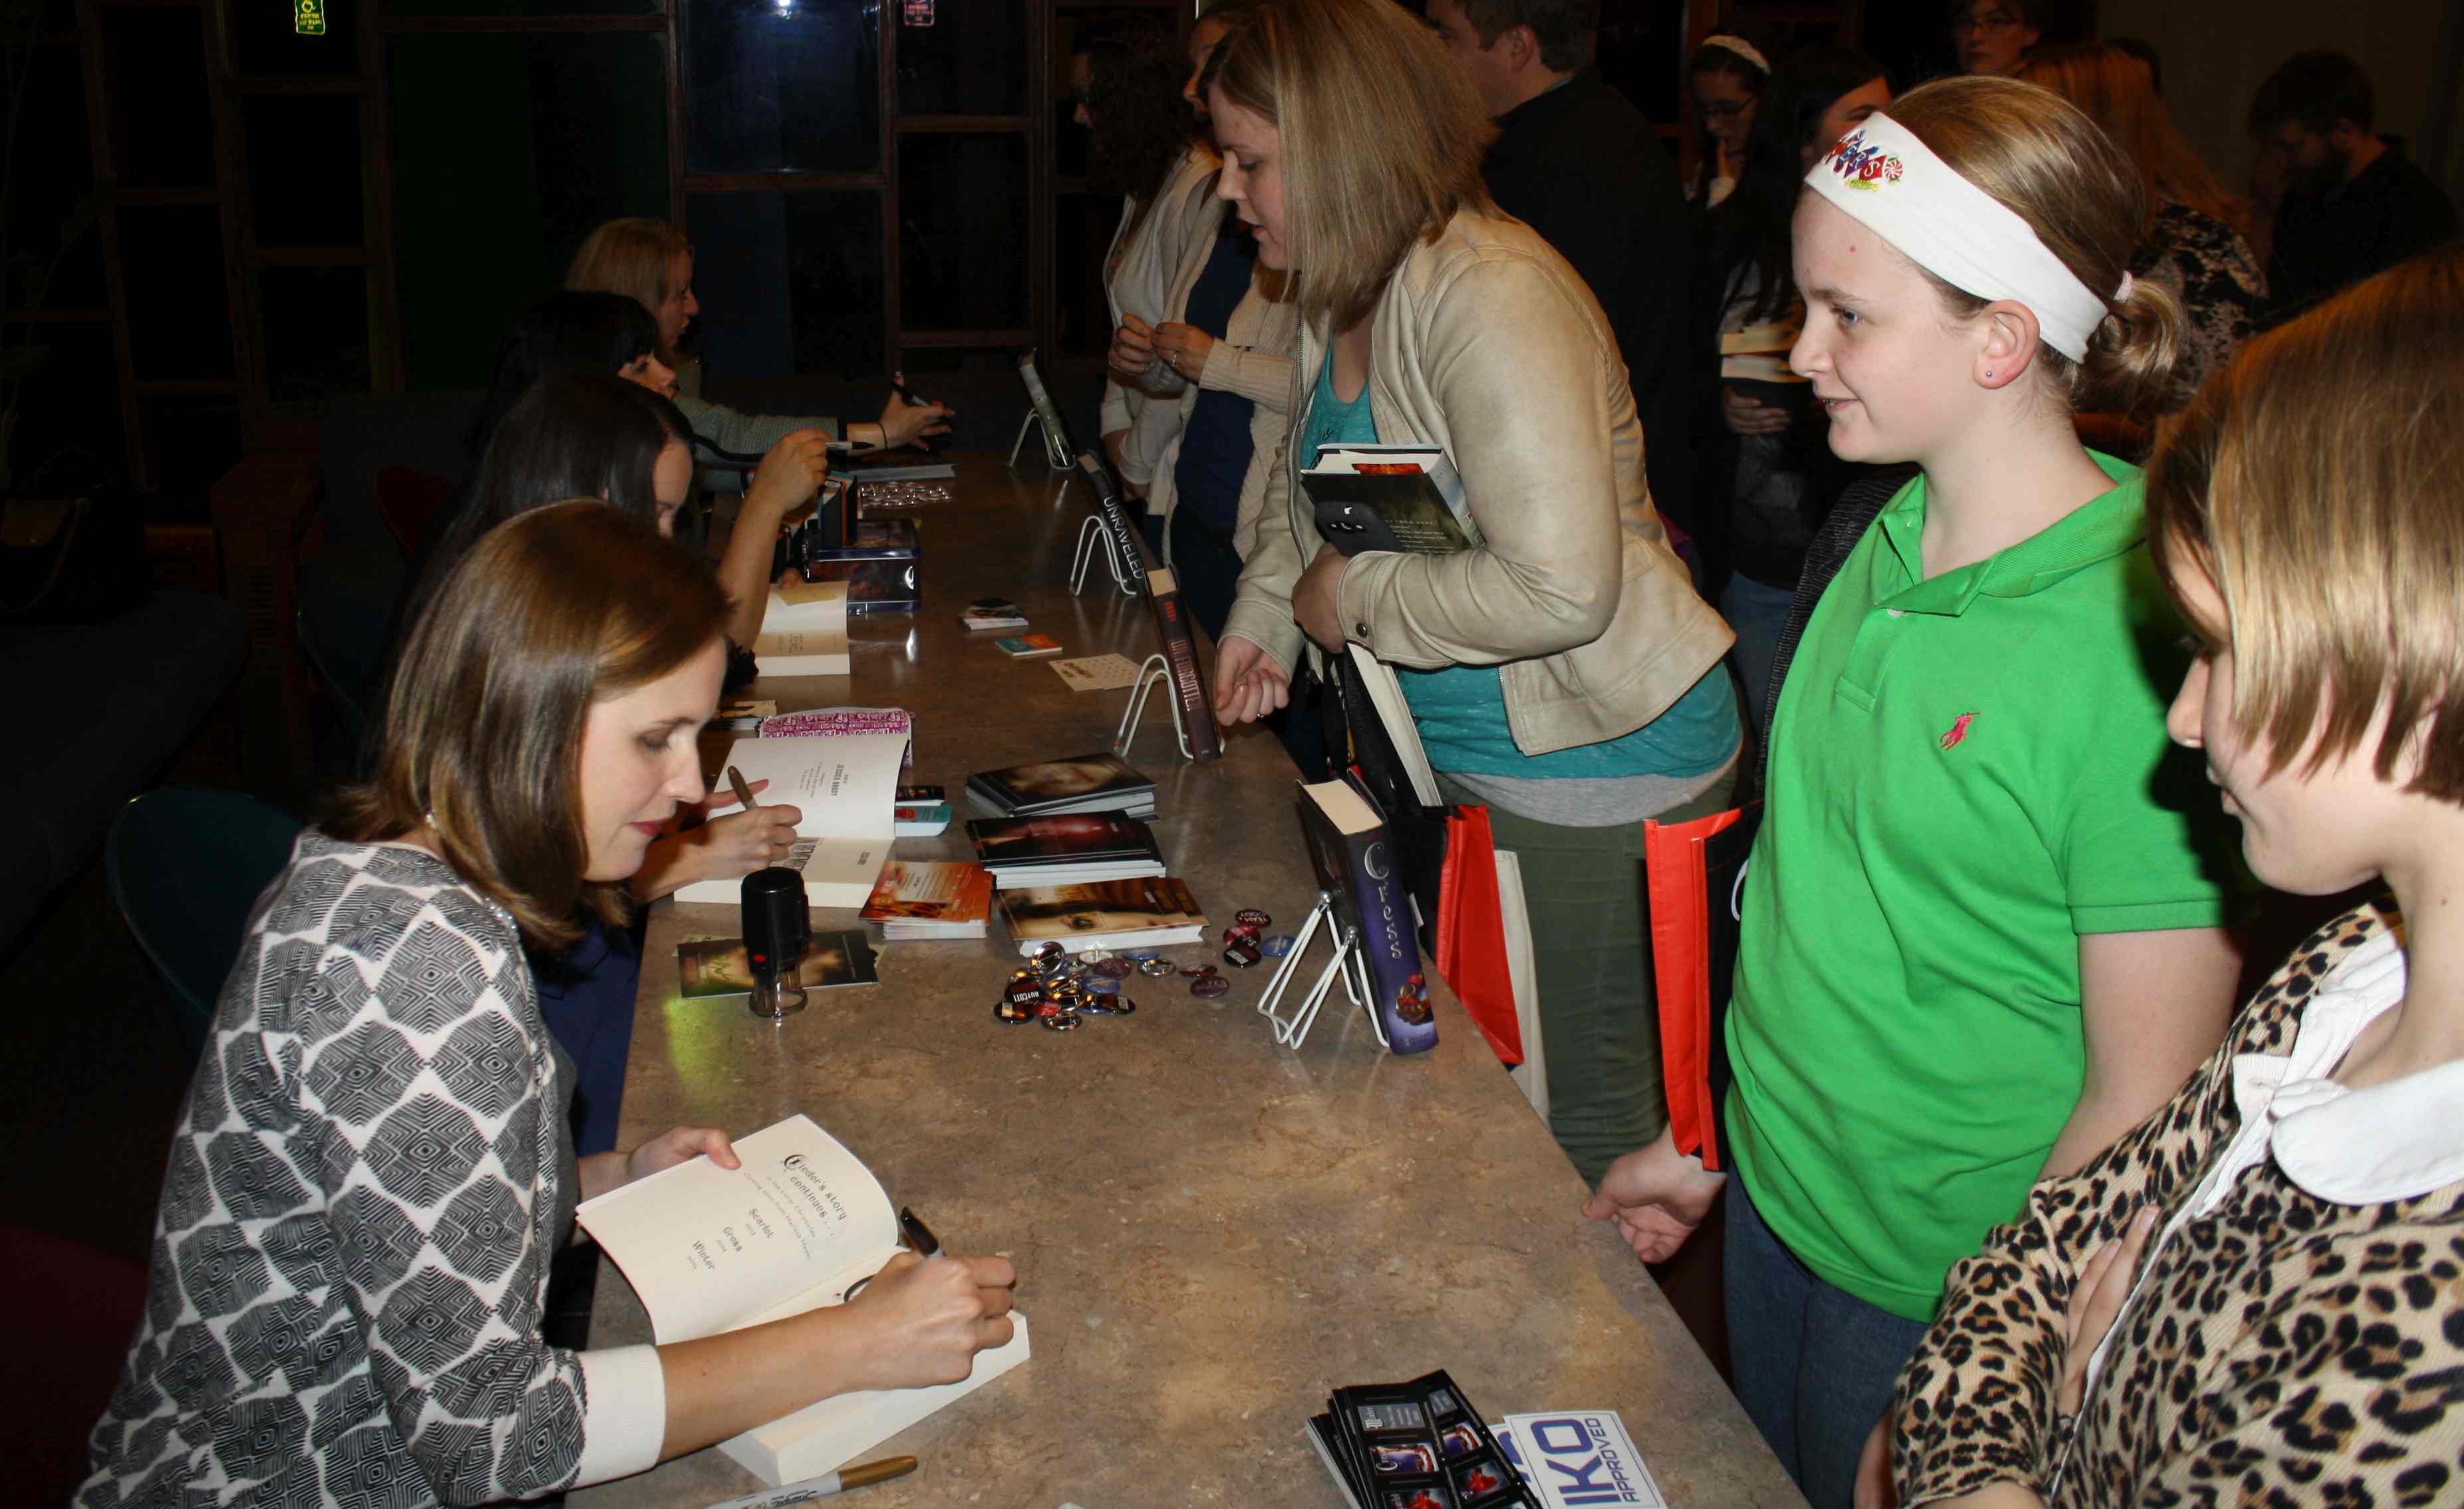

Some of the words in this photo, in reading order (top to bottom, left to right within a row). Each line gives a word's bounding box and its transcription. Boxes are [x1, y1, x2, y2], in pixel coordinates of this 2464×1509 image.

[1104, 496, 1144, 579] UNRAVELED
[1364, 842, 1403, 959] Cress
[748, 1208, 774, 1238] Scarlet
[783, 1154, 827, 1191] Cinder's
[825, 1192, 847, 1221] story
[790, 1176, 828, 1218] continues
[692, 1240, 715, 1270] Winter
[1531, 1418, 1622, 1506] IKO
[1584, 1417, 1641, 1504] APPROVED
